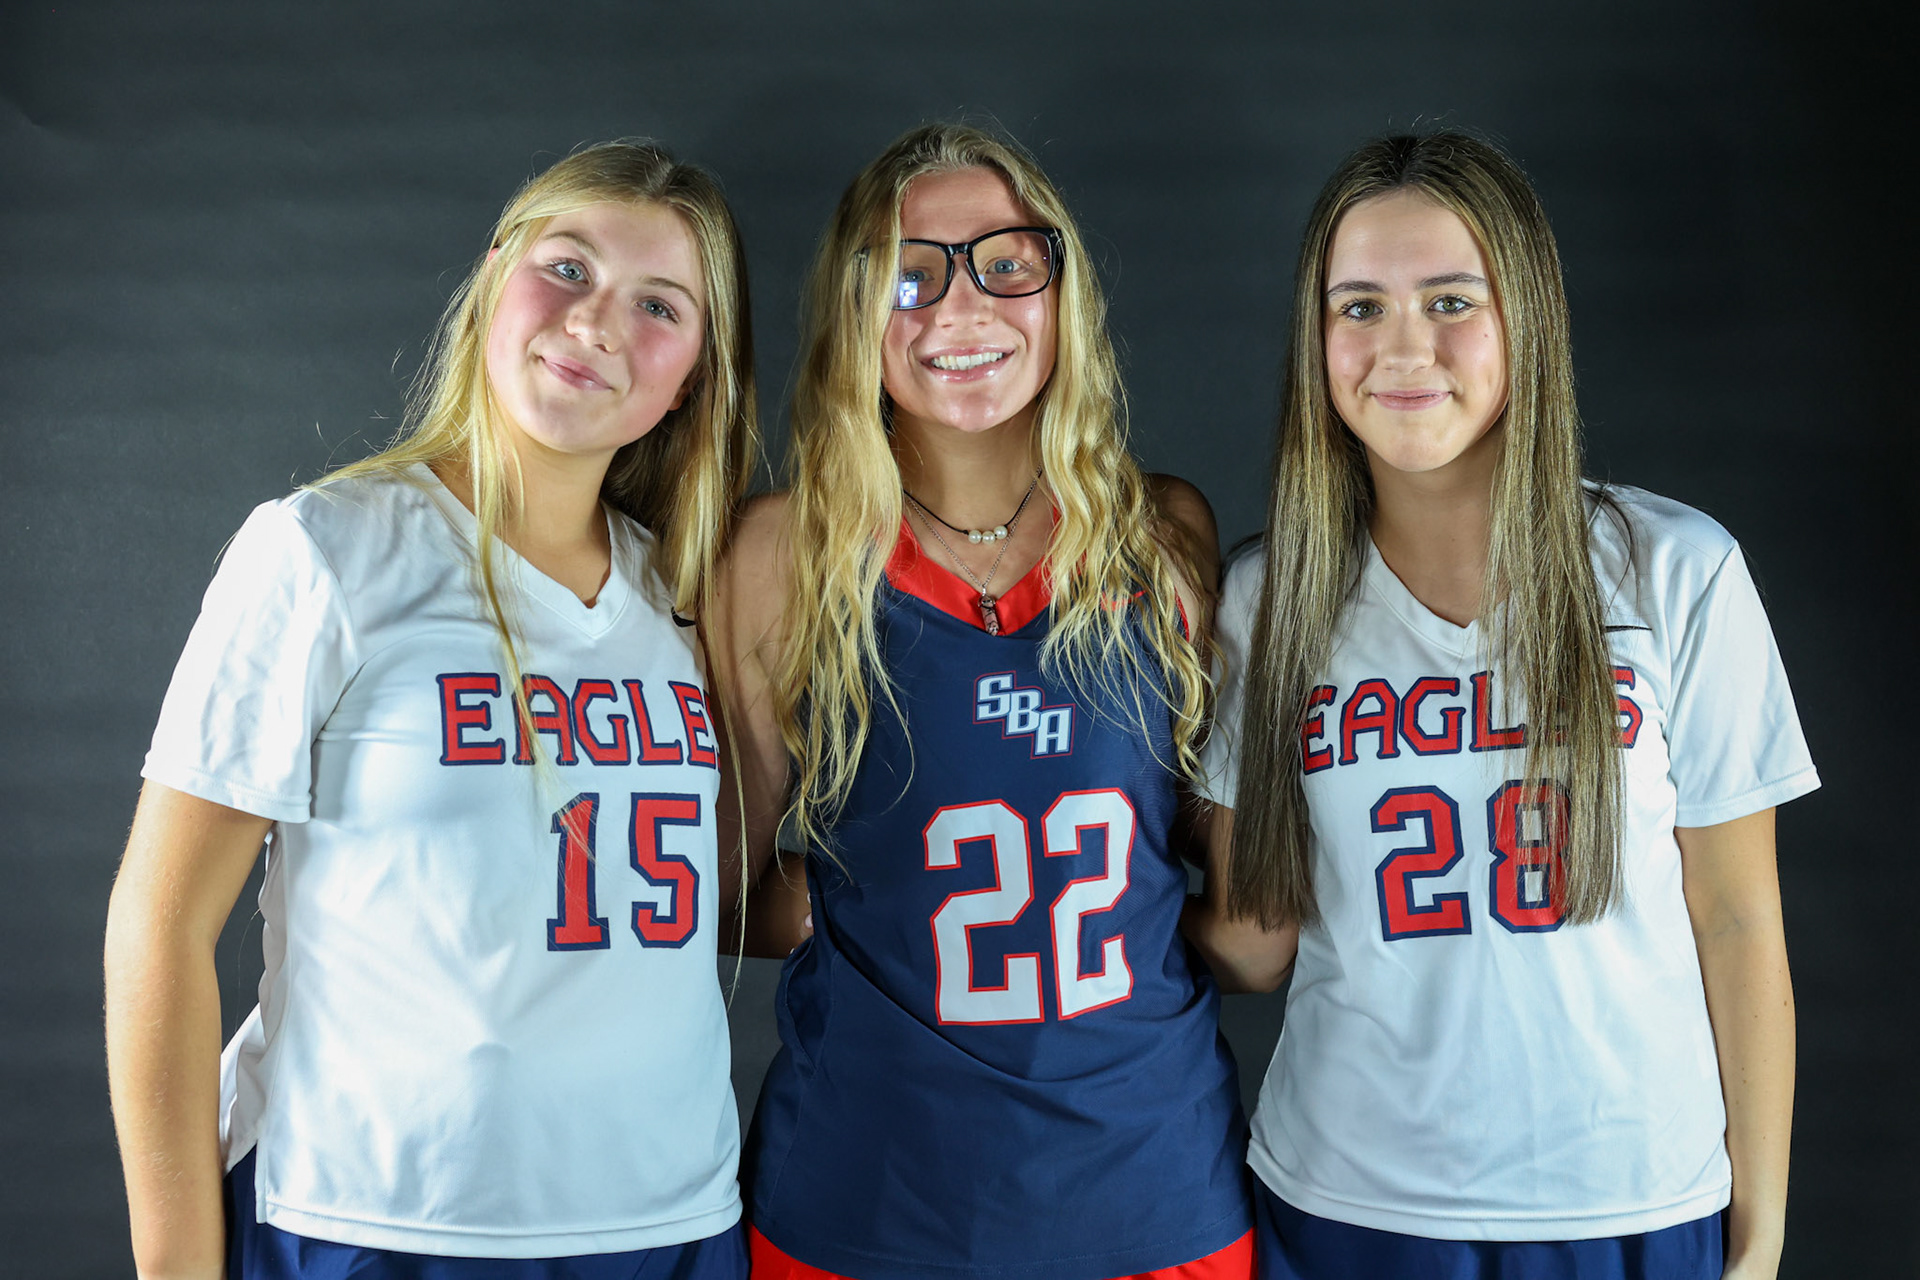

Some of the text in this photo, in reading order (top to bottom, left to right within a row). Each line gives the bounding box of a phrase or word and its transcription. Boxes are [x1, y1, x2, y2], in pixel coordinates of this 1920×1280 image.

[436, 672, 720, 768] EAGLE
[974, 671, 1075, 759] SBA
[1300, 666, 1643, 775] EAGLS
[547, 792, 701, 951] 15
[922, 788, 1135, 1025] 22
[1370, 778, 1571, 942] 28
